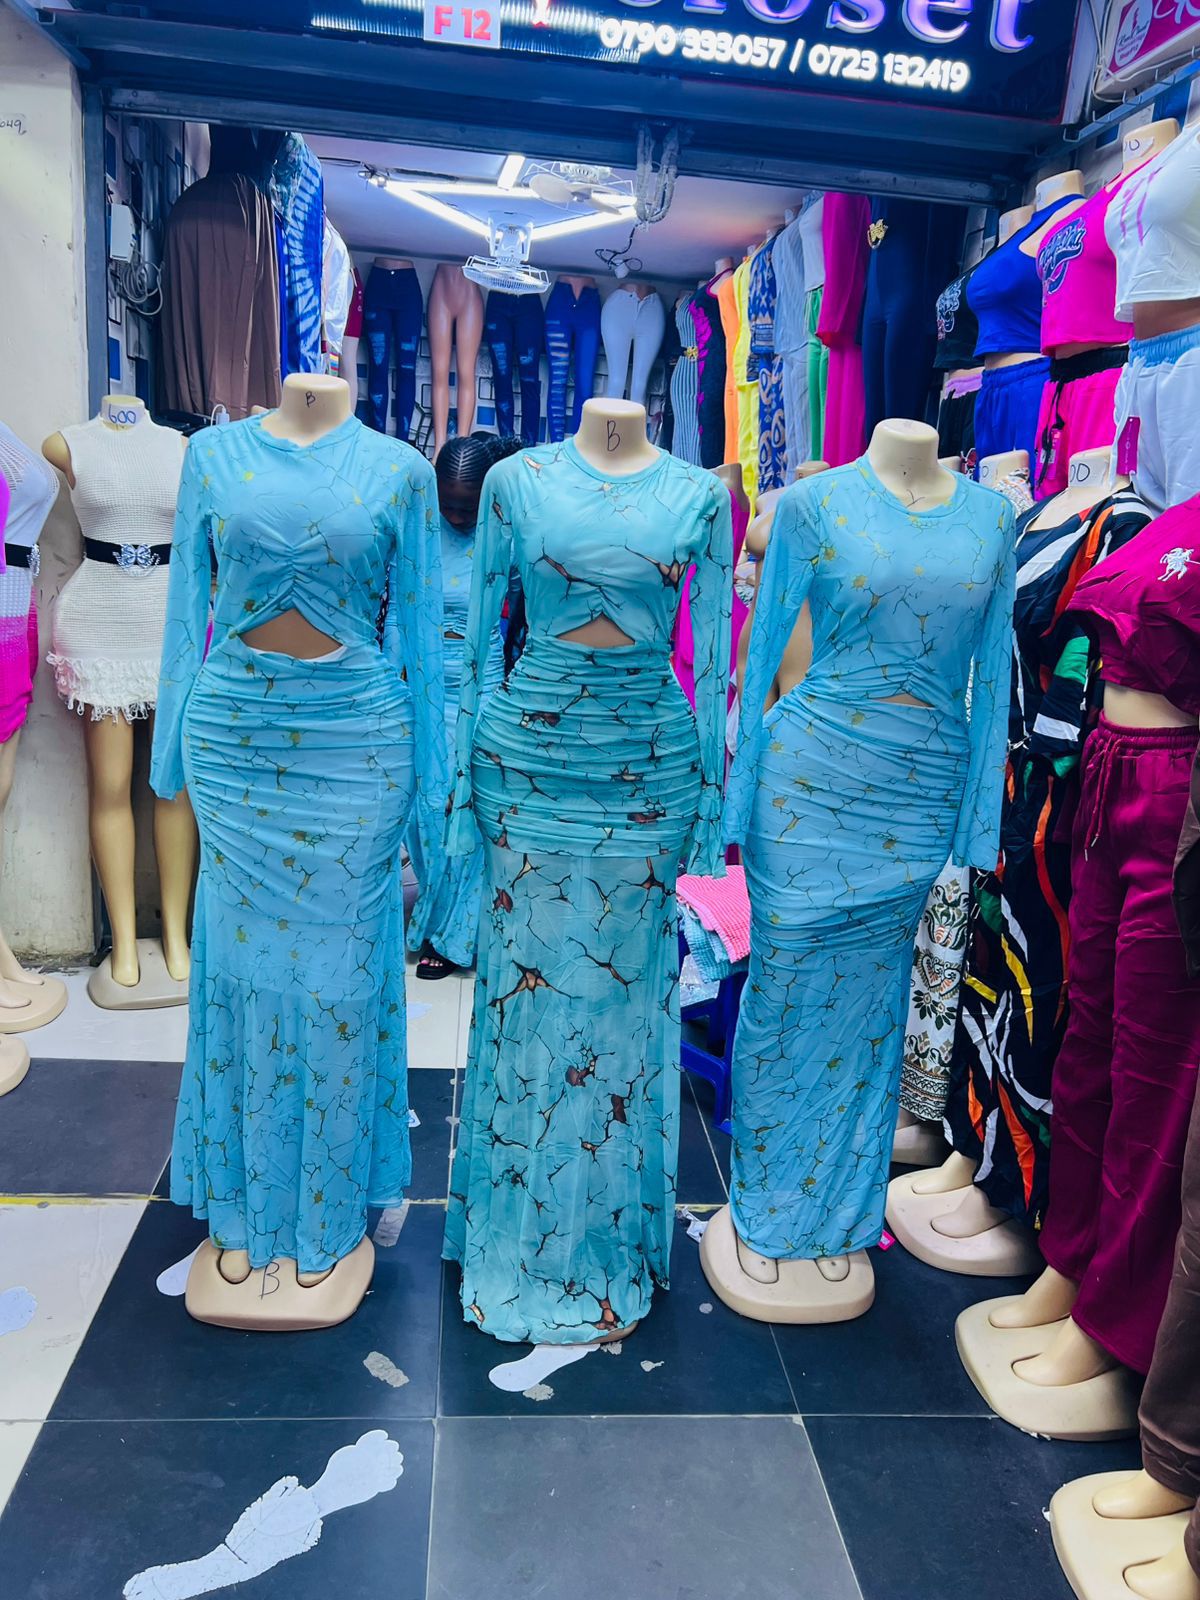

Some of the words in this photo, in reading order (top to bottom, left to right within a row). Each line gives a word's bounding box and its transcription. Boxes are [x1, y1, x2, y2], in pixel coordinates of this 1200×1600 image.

[433, 6, 453, 35] F
[461, 8, 491, 40] 12
[600, 18, 677, 56] 0790
[808, 43, 879, 82] 0723
[882, 52, 970, 93] 132419
[108, 403, 137, 424] 600
[305, 390, 317, 408] B
[606, 419, 621, 452] B
[260, 1261, 281, 1300] B
